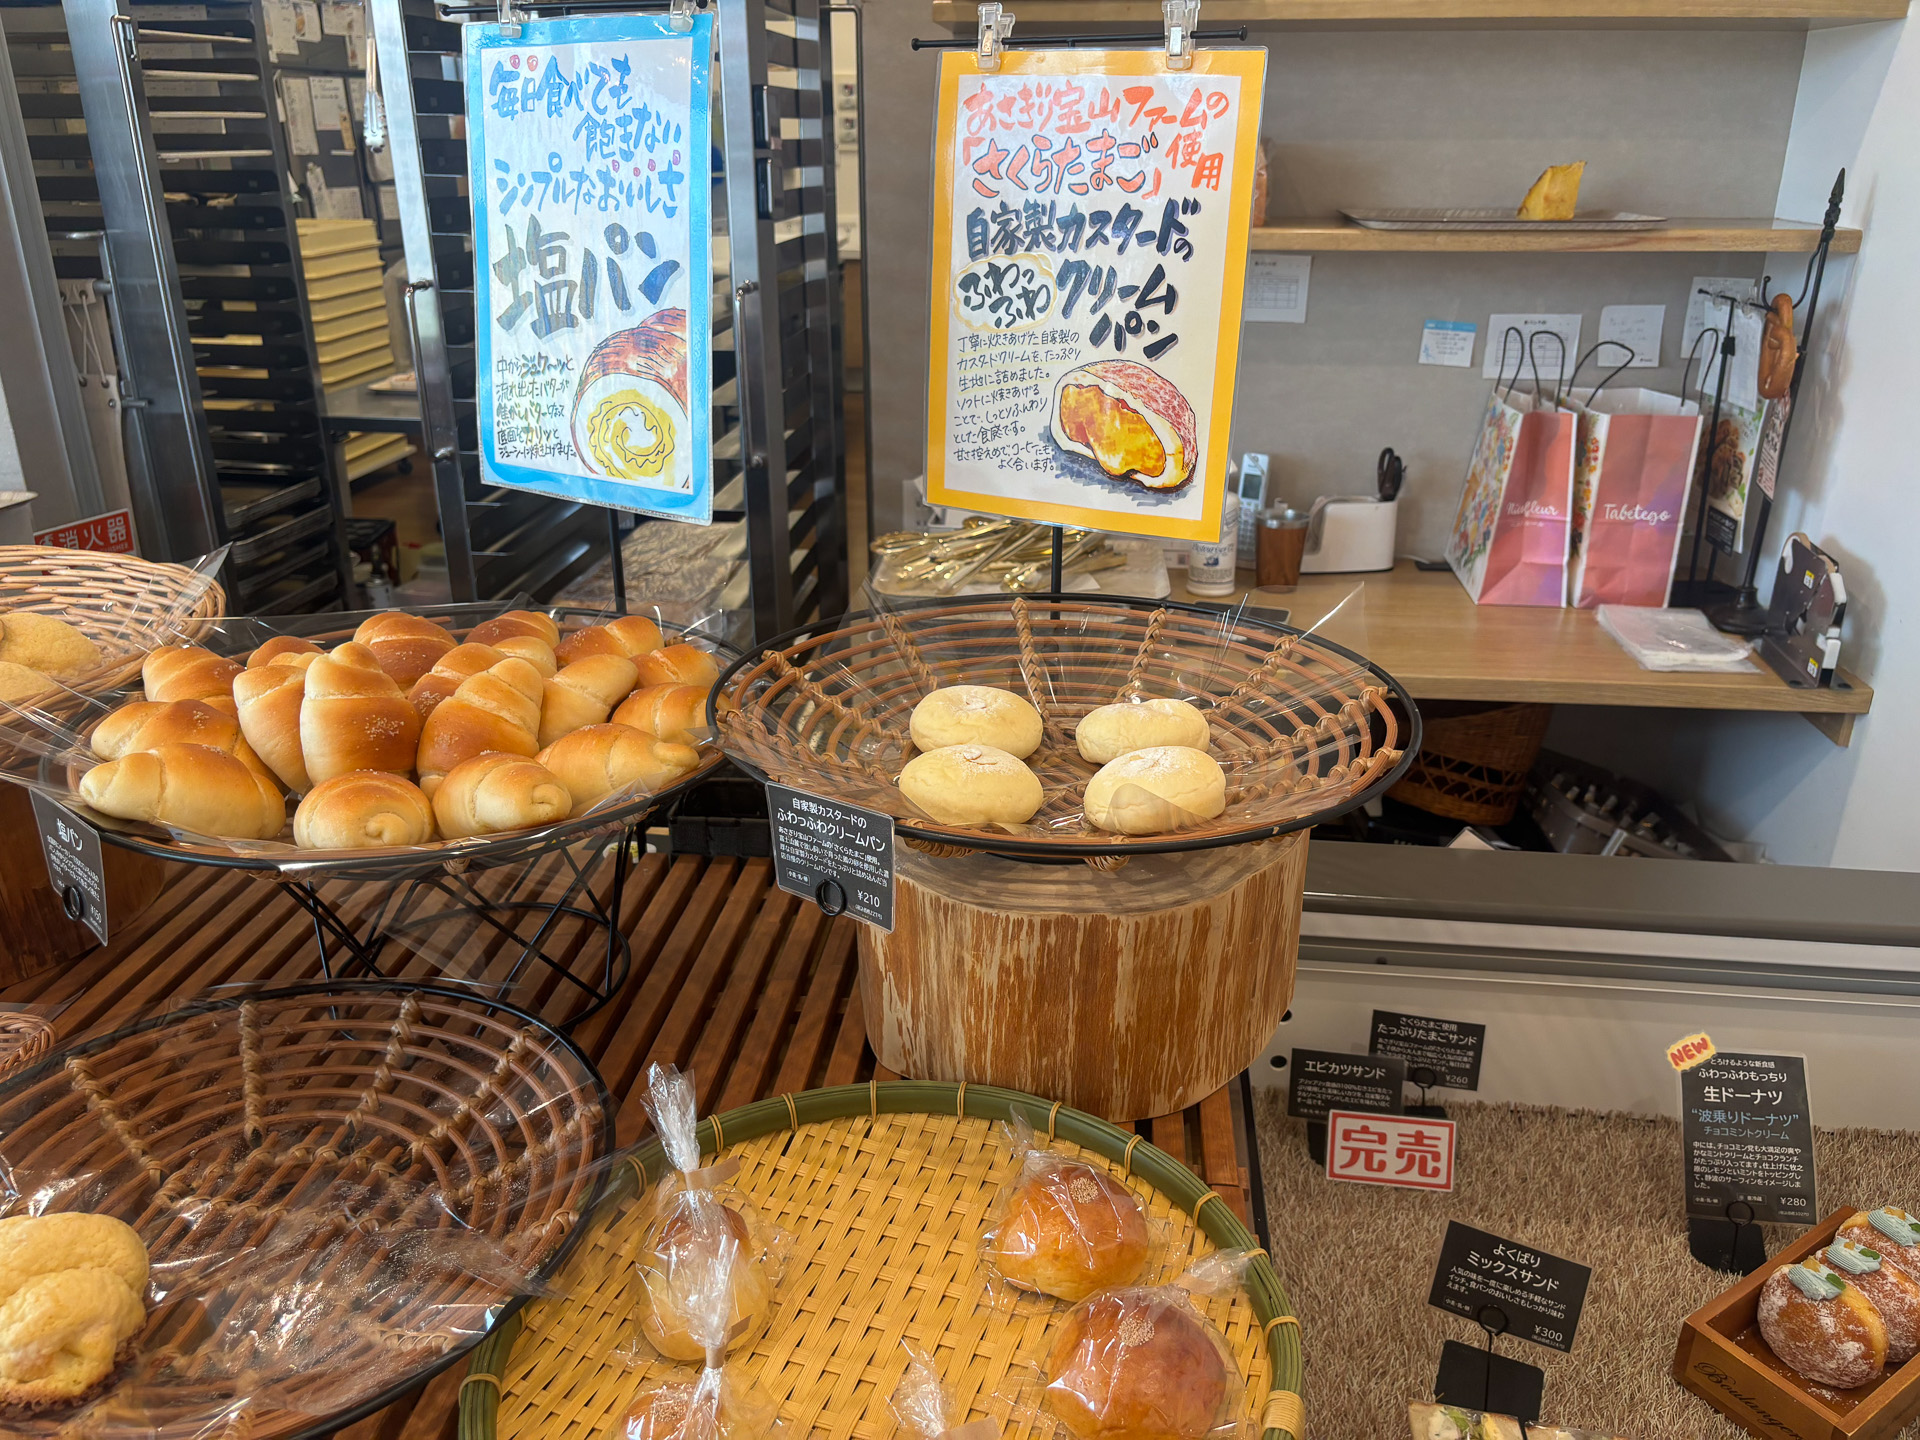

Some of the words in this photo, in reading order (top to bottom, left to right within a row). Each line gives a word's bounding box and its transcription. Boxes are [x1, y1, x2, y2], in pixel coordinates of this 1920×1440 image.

[489, 53, 633, 121] 毎日食べても
[963, 79, 1230, 136] あさぎり宝山ファームの
[572, 102, 682, 162] 飽きない
[962, 129, 1163, 199] 「さくらたまご」
[1165, 131, 1225, 191] 使用
[494, 151, 685, 218] シンプルなおいしさ
[966, 197, 1201, 262] 自家製カスタードの
[492, 213, 681, 340] 塩パン
[1055, 258, 1178, 319] クリーム
[1089, 310, 1179, 362] パン
[958, 367, 1050, 392] 生地に詰めました。
[957, 384, 1040, 411] ソフトに焼きあげる
[953, 420, 1026, 444] とした食感です。
[997, 457, 1055, 473] よく合います。
[1604, 503, 1671, 524] Tabetego
[58, 516, 127, 550] 消火器
[792, 797, 867, 829] 自家製カスタードの
[57, 818, 83, 851] 塩パン
[777, 807, 886, 852] ふわっふわクリームパン
[857, 889, 880, 908] ¥210
[1377, 1023, 1478, 1046] たっぷりたまごサンド
[1400, 1017, 1458, 1032] さくらたまご使用
[1669, 1036, 1709, 1067] NEW
[1304, 1060, 1387, 1079] エビカツサンド
[1698, 1067, 1788, 1083] ふわっふわもっちり
[1703, 1085, 1783, 1105] 生ドーナツ
[1703, 1126, 1790, 1140] チョコミントクリーム
[1338, 1125, 1442, 1179] 完売
[1780, 1197, 1807, 1207] ¥280
[1466, 1250, 1560, 1292] ミックスサンド
[1492, 1243, 1541, 1268] よくばり
[1446, 1281, 1469, 1295] えます。
[1533, 1324, 1564, 1342] ¥300
